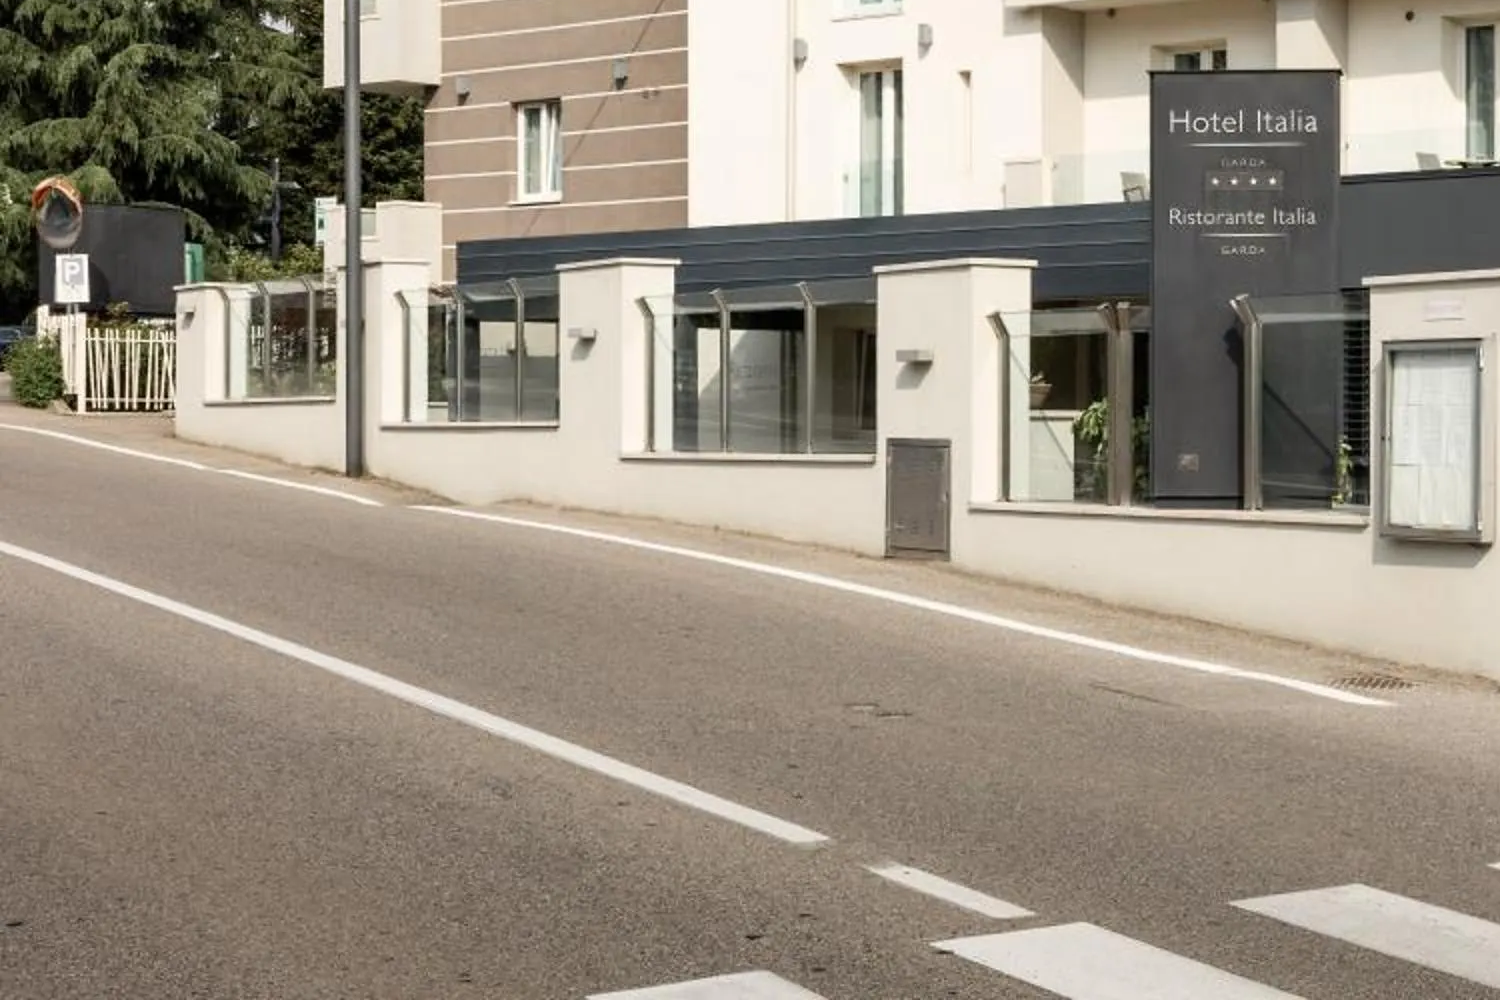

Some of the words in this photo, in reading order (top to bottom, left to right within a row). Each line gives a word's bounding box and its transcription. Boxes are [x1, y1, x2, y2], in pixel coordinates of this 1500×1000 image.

[1168, 109, 1244, 133] Hotel
[1256, 109, 1318, 133] Italia
[1168, 207, 1265, 225] Ristorante
[1272, 207, 1318, 225] Italia
[1220, 246, 1266, 255] GARDA
[64, 261, 81, 282] P
